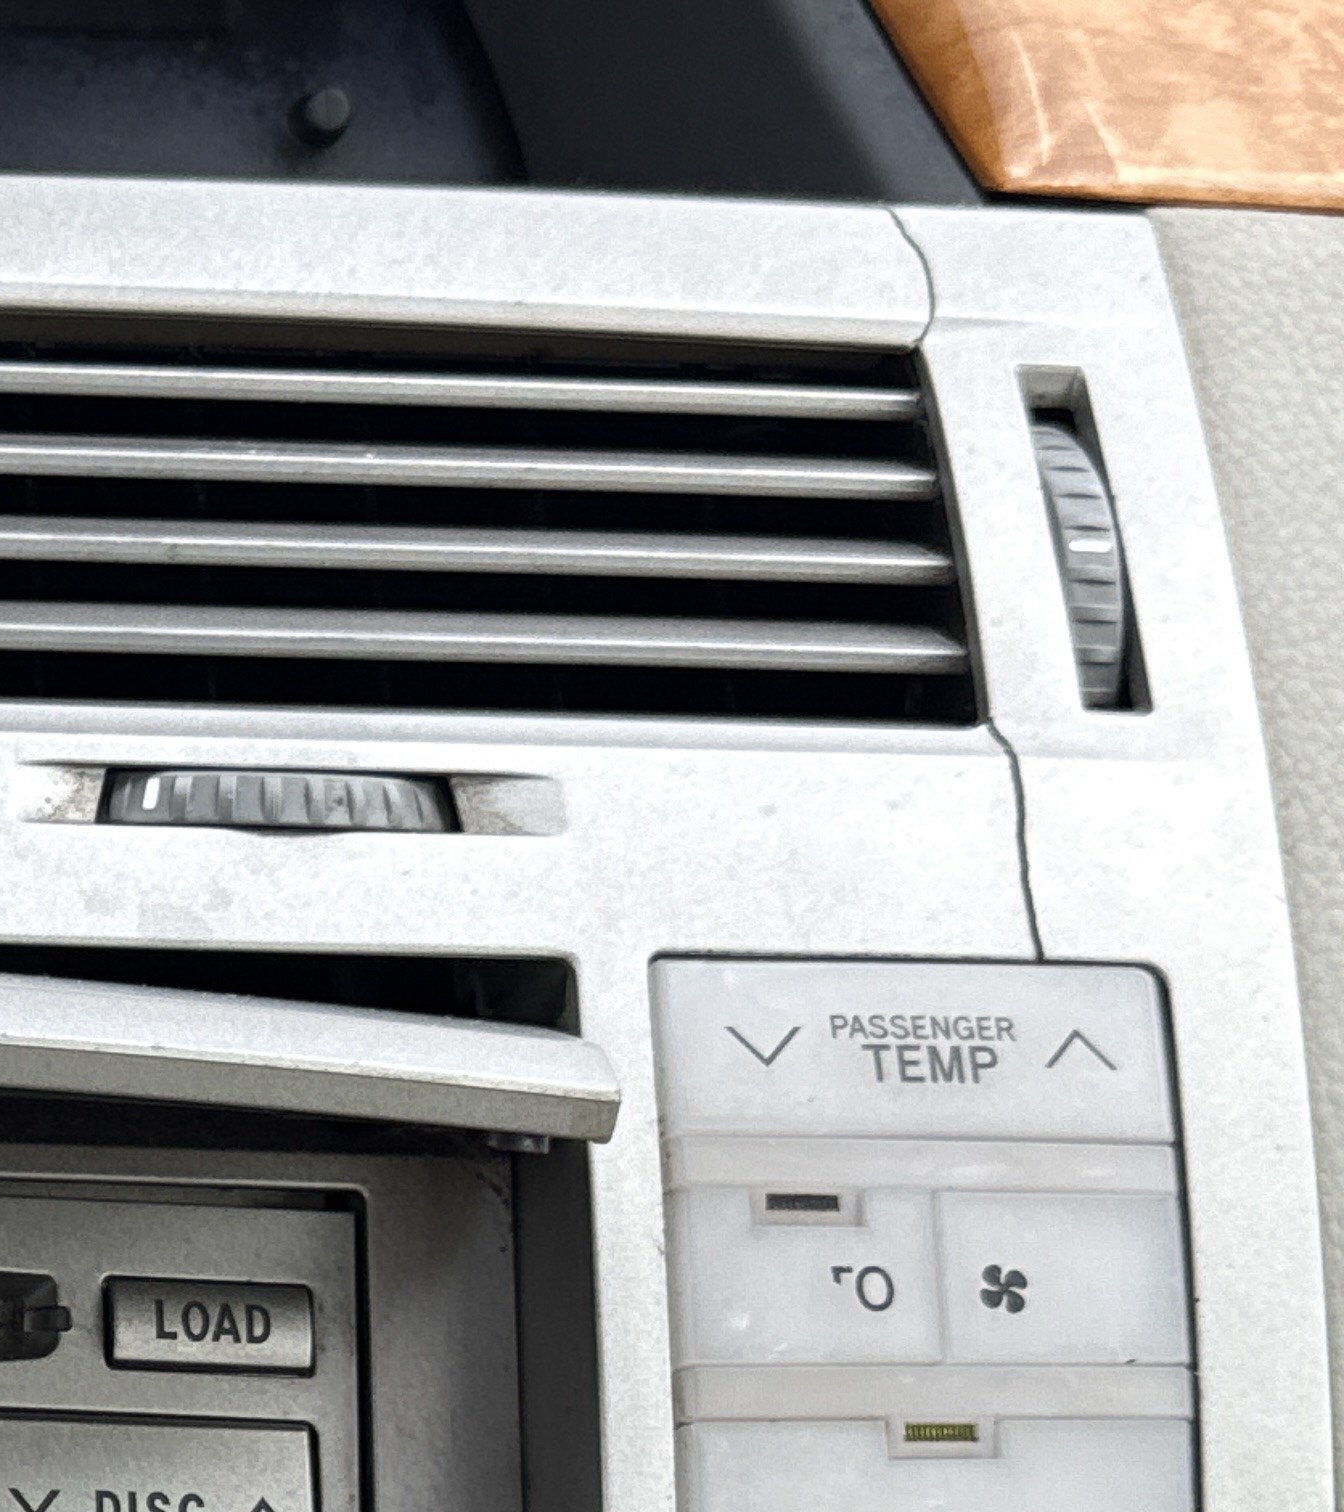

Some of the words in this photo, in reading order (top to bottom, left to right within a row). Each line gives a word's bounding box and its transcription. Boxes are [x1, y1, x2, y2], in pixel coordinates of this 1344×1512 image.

[829, 1014, 1017, 1042] PASSENGER
[861, 1043, 999, 1084] TEMP
[153, 1299, 272, 1344] LOAD
